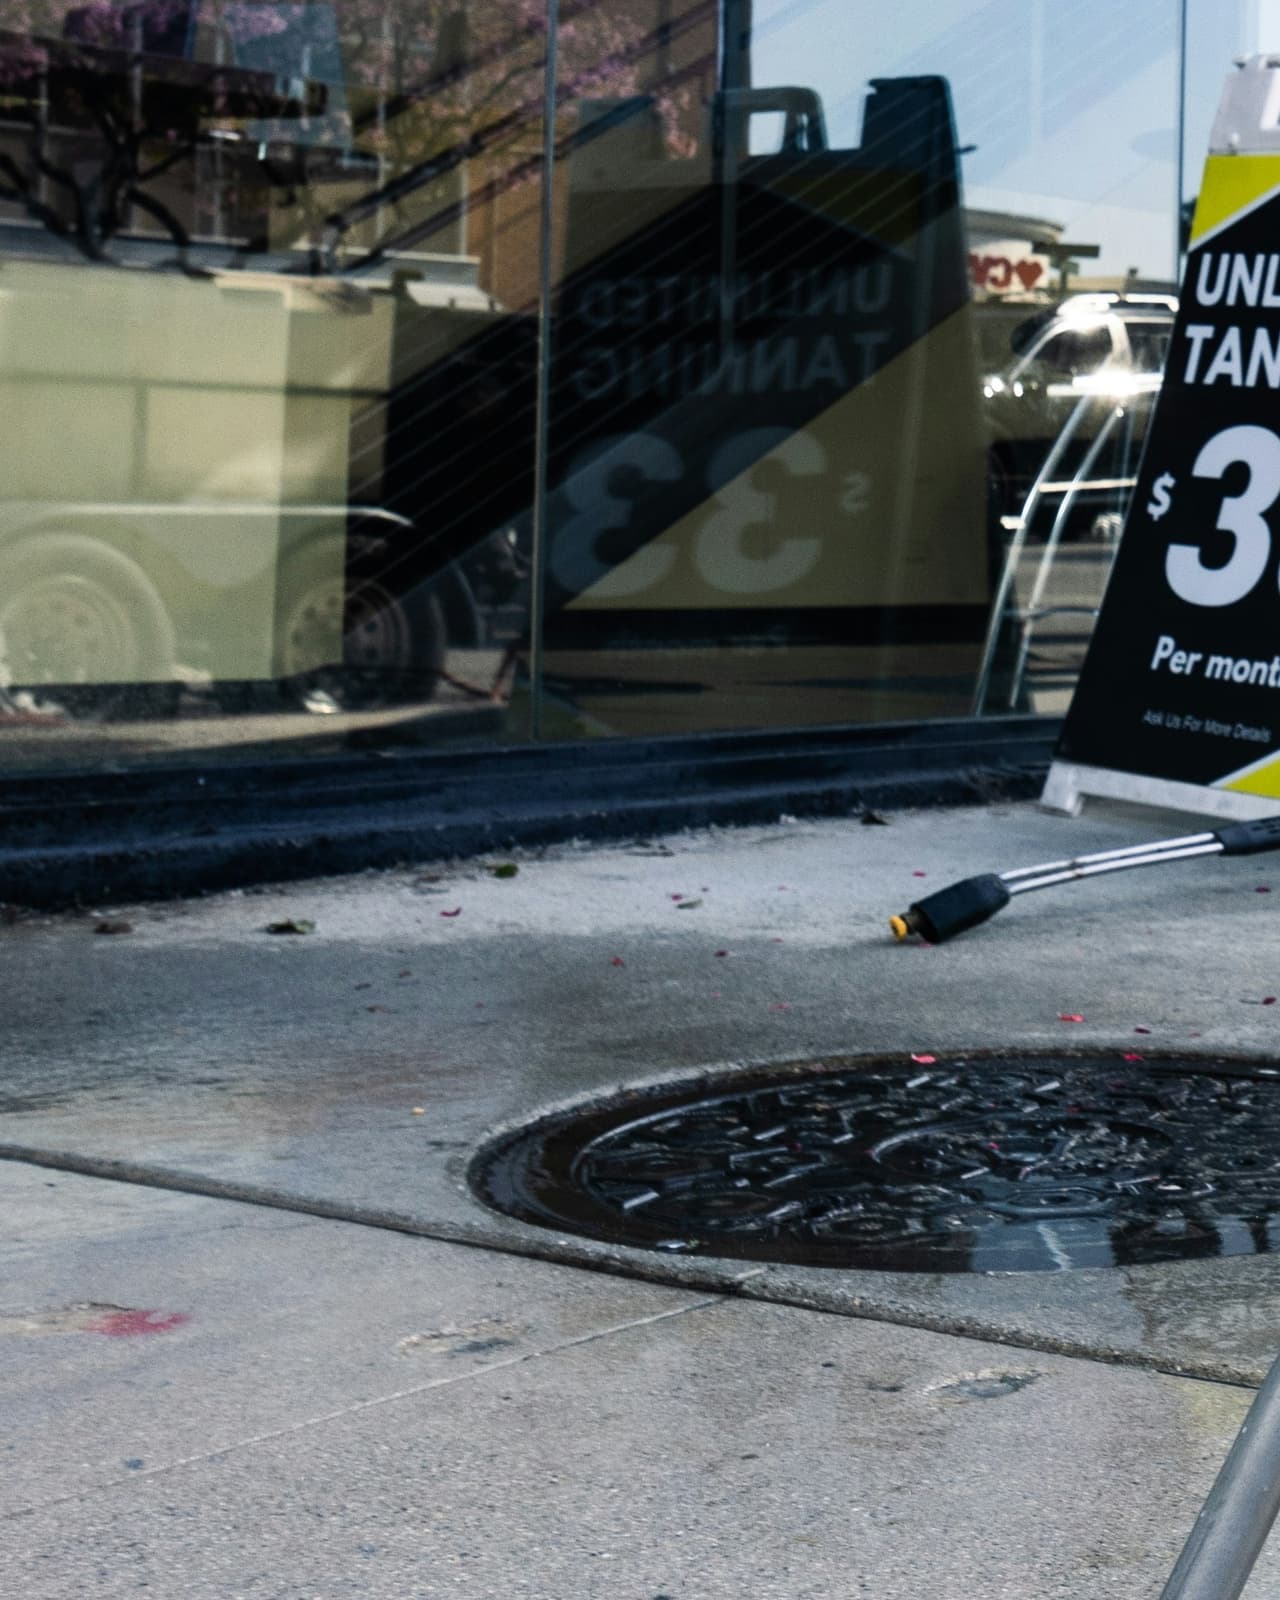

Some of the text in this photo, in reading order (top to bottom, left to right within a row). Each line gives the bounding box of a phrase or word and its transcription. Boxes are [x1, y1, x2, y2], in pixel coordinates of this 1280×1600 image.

[1151, 635, 1201, 677] Per
[1143, 708, 1271, 743] Ask Us For More Details
